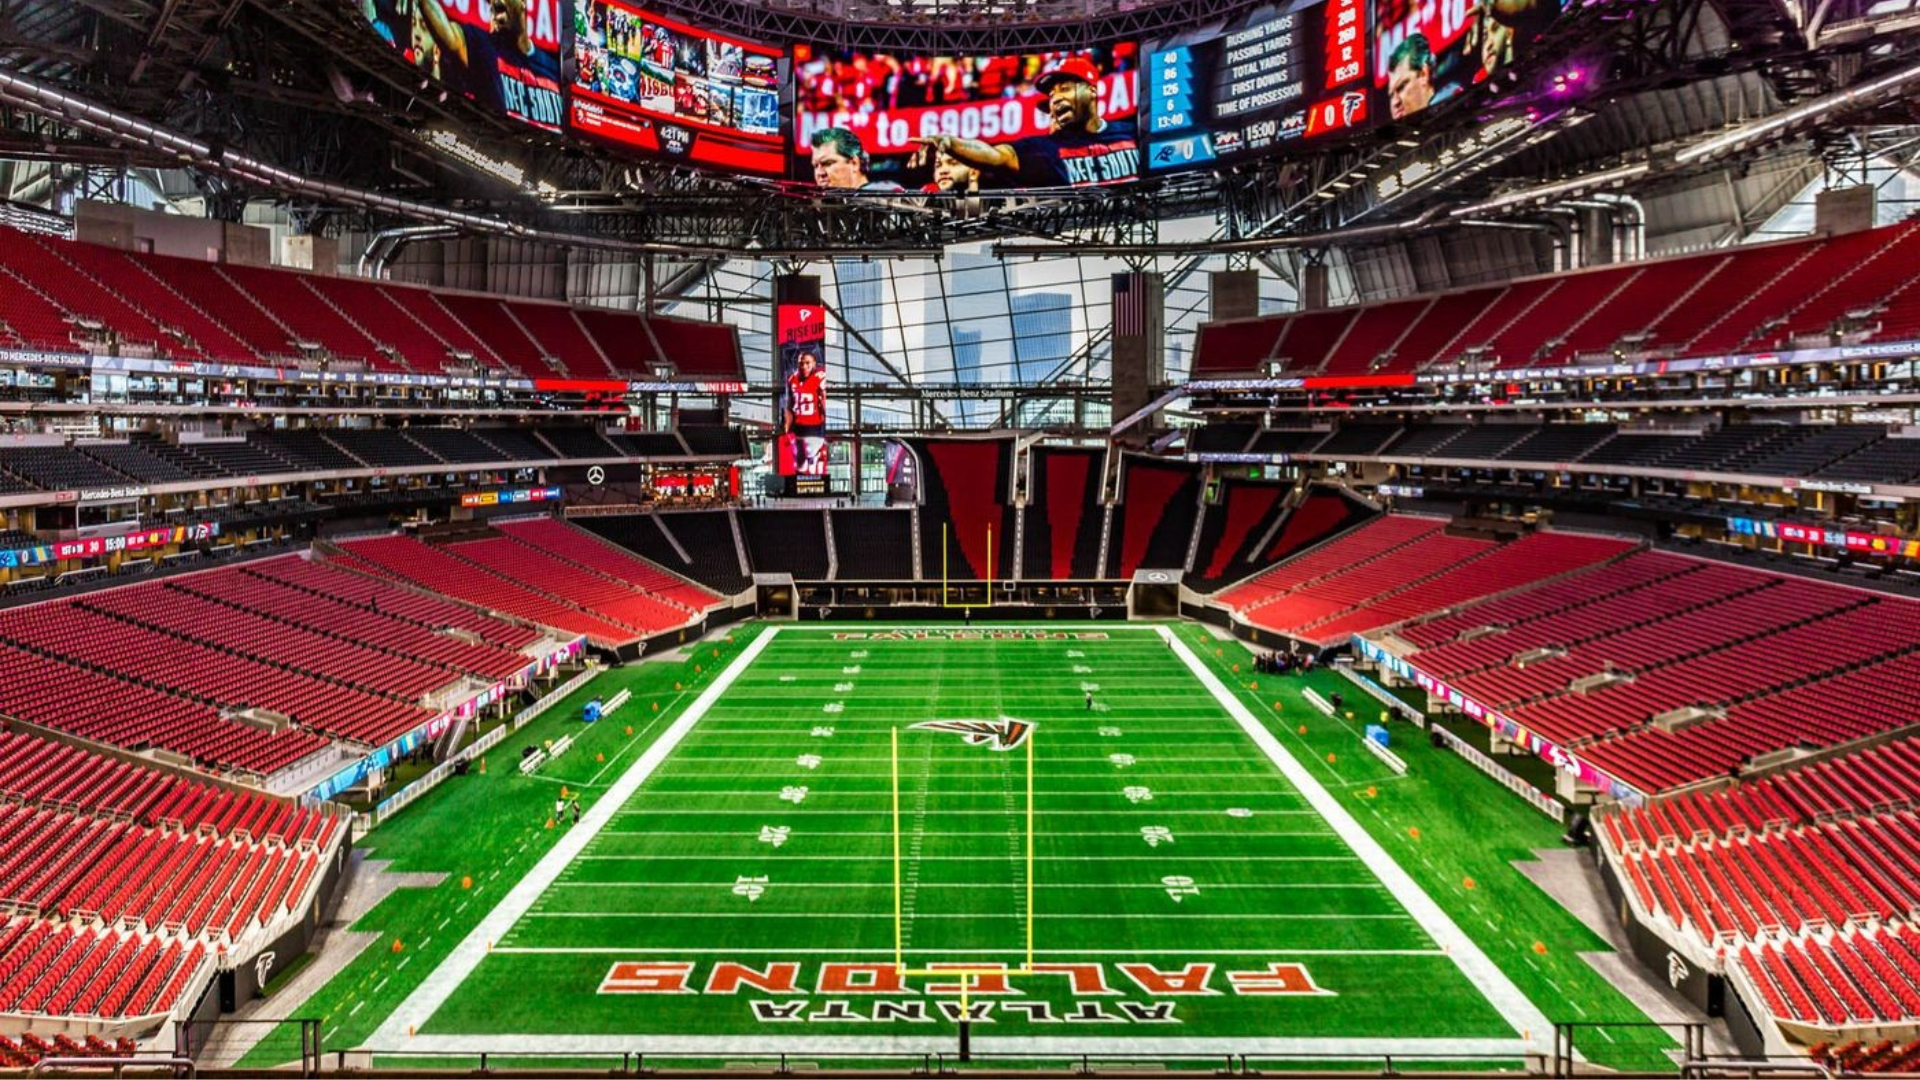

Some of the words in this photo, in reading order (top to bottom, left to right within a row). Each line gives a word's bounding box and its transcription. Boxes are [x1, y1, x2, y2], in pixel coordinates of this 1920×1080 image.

[1226, 26, 1264, 48] RUSHING
[1264, 15, 1293, 36] YARDS
[1163, 51, 1178, 64] 40
[1227, 43, 1264, 64] PASSING
[1264, 34, 1292, 53] YARDS
[1164, 67, 1178, 80] 86
[1232, 61, 1259, 79] TOTAL
[1260, 53, 1288, 71] YARDS
[1162, 82, 1179, 96] 126
[1232, 80, 1256, 96] FIRST
[1256, 70, 1288, 93] DOWNS
[1166, 99, 1175, 111] 6
[1217, 100, 1238, 116] TIME
[1239, 97, 1251, 110] OF
[1251, 82, 1303, 107] POSSESSION
[876, 111, 909, 147] to
[920, 100, 1023, 139] 69050
[1158, 113, 1183, 128] 13:40
[1325, 105, 1335, 126] 0
[1246, 120, 1276, 141] 15:00
[1183, 139, 1195, 159] 0
[921, 389, 980, 398] Mercedes-Benz
[981, 389, 1014, 398] Stadium
[81, 487, 125, 500] Mercedes-Benz
[126, 486, 149, 497] Stadium
[105, 537, 126, 550] 15:00
[732, 874, 769, 896] 10
[1161, 875, 1200, 897] 10
[596, 962, 1339, 996] FALCONS
[749, 1000, 1184, 1023] ATLANTA
